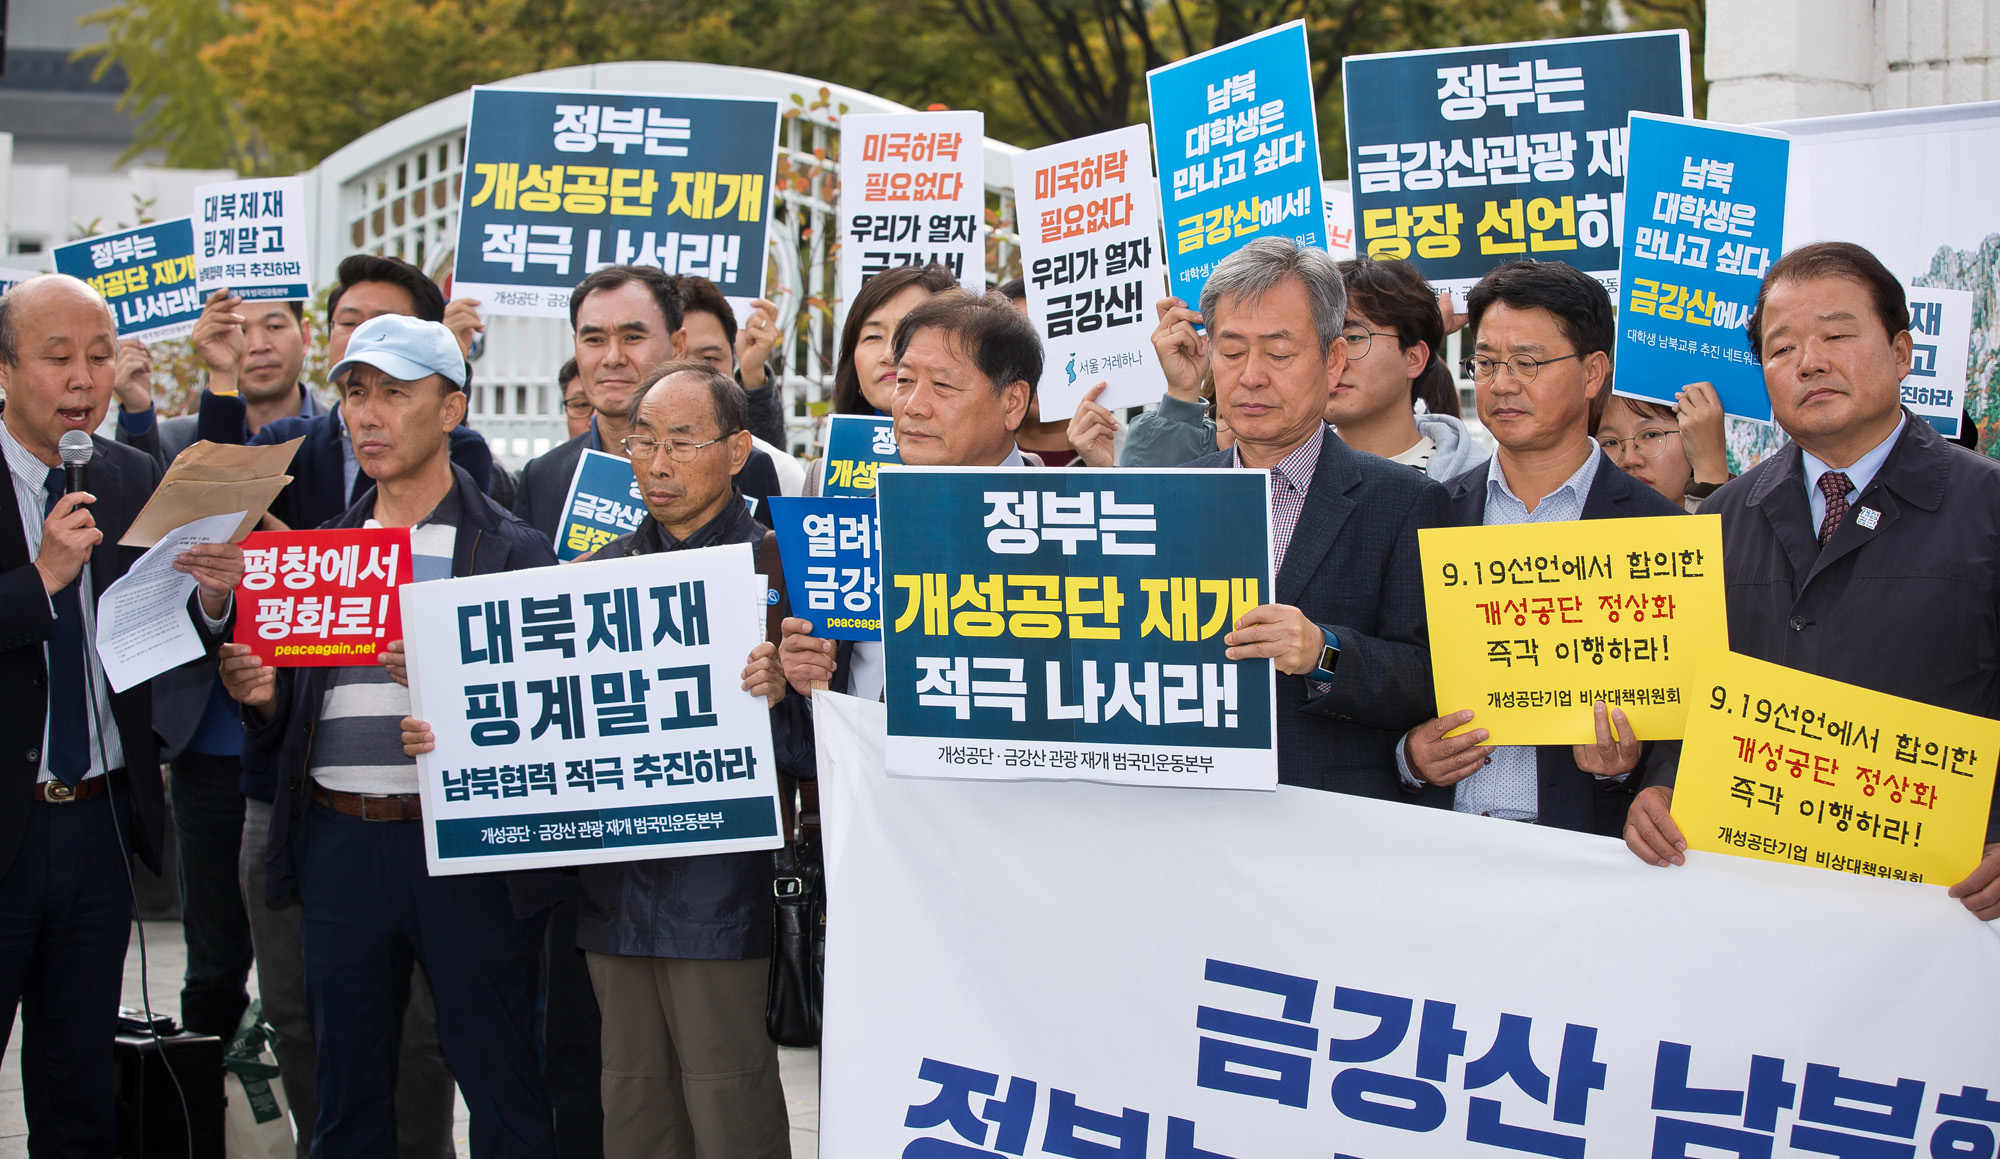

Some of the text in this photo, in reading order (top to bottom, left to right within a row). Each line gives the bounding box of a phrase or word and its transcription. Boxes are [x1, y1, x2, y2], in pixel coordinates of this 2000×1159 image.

[1207, 69, 1257, 115] 남북
[1436, 58, 1585, 121] 정부는
[553, 105, 691, 157] 정부는
[862, 132, 962, 162] 미국허락
[1185, 99, 1285, 159] 대학생은
[1034, 150, 1128, 200] 미국허락
[1173, 131, 1306, 202] 만나고 싶다
[1357, 127, 1629, 194] 금강산관광 재
[1681, 156, 1735, 195] 남북
[204, 190, 283, 223] 대북제재
[470, 162, 764, 222] 개성공단 재개
[864, 172, 963, 202] 필요없다
[850, 215, 976, 243] 우리가 열자
[1040, 193, 1134, 244] 필요없다
[1177, 186, 1311, 255] 금강산에서!
[1363, 192, 1623, 262] 당장 선언하
[1652, 191, 1757, 238] 대학생은
[90, 234, 158, 269] 정부는
[204, 226, 285, 258] 핑계말고
[482, 224, 741, 283] 적극 나서라!
[1031, 237, 1151, 290] 우리가 열자
[1635, 226, 1771, 279] 만나고 싶다
[85, 254, 195, 299] 성공단 재개
[225, 263, 246, 278] 적극
[250, 261, 301, 278] 추진하라
[1180, 263, 1210, 283] 대학생
[494, 291, 539, 306] 개성공단
[547, 293, 571, 308] 금강
[1046, 281, 1143, 339] 금강산!
[1908, 302, 1942, 336] 재
[1079, 350, 1143, 375] 서울 겨레하나
[1627, 329, 1656, 347] 대학생
[1659, 335, 1697, 355] 남북교류
[1700, 343, 1720, 360] 추진
[1909, 343, 1937, 377] 고
[1901, 385, 1953, 408] 진하라
[828, 460, 890, 490] 개성
[572, 492, 648, 532] 금강산
[983, 490, 1157, 556] 정부는
[803, 514, 880, 559] 열려
[241, 544, 400, 591] 평창에서
[804, 566, 880, 613] 금강
[1442, 549, 1704, 587] 9.19선언에서 합의한
[255, 594, 390, 641] 평화로!
[457, 579, 711, 665] 대북제재
[827, 617, 881, 630] peaceaga
[893, 573, 1259, 642] 개성공단 재개
[1476, 593, 1676, 626] 개성공단 정상화
[275, 642, 376, 657] peaceagain.net
[1487, 635, 1670, 668] 즉각 이행하라!
[464, 664, 719, 747] 핑계말고
[915, 656, 1239, 728] 적극 나서라!
[1487, 687, 1681, 709] 개성공단기업 비상대책위원회
[1709, 685, 1978, 778] 9.19선언에서 합의한
[442, 746, 757, 802] 남북협력 적극 추진하라
[938, 746, 994, 766] 개성공단
[1003, 748, 1047, 768] 금강산
[1048, 750, 1078, 769] 관광
[1081, 751, 1110, 770] 재개
[1112, 752, 1215, 774] 범국민운동본부
[1732, 735, 1938, 810] 개성공단 정상화
[481, 825, 530, 845] 개성공단
[538, 822, 577, 841] 금강산
[577, 820, 604, 839] 관광
[606, 817, 632, 836] 재개
[633, 811, 725, 835] 범국민운동본부
[1730, 775, 1923, 848] 즉각 이행하라!
[1717, 826, 1808, 863] 개성공단기업
[1196, 958, 1607, 1159] 금강산
